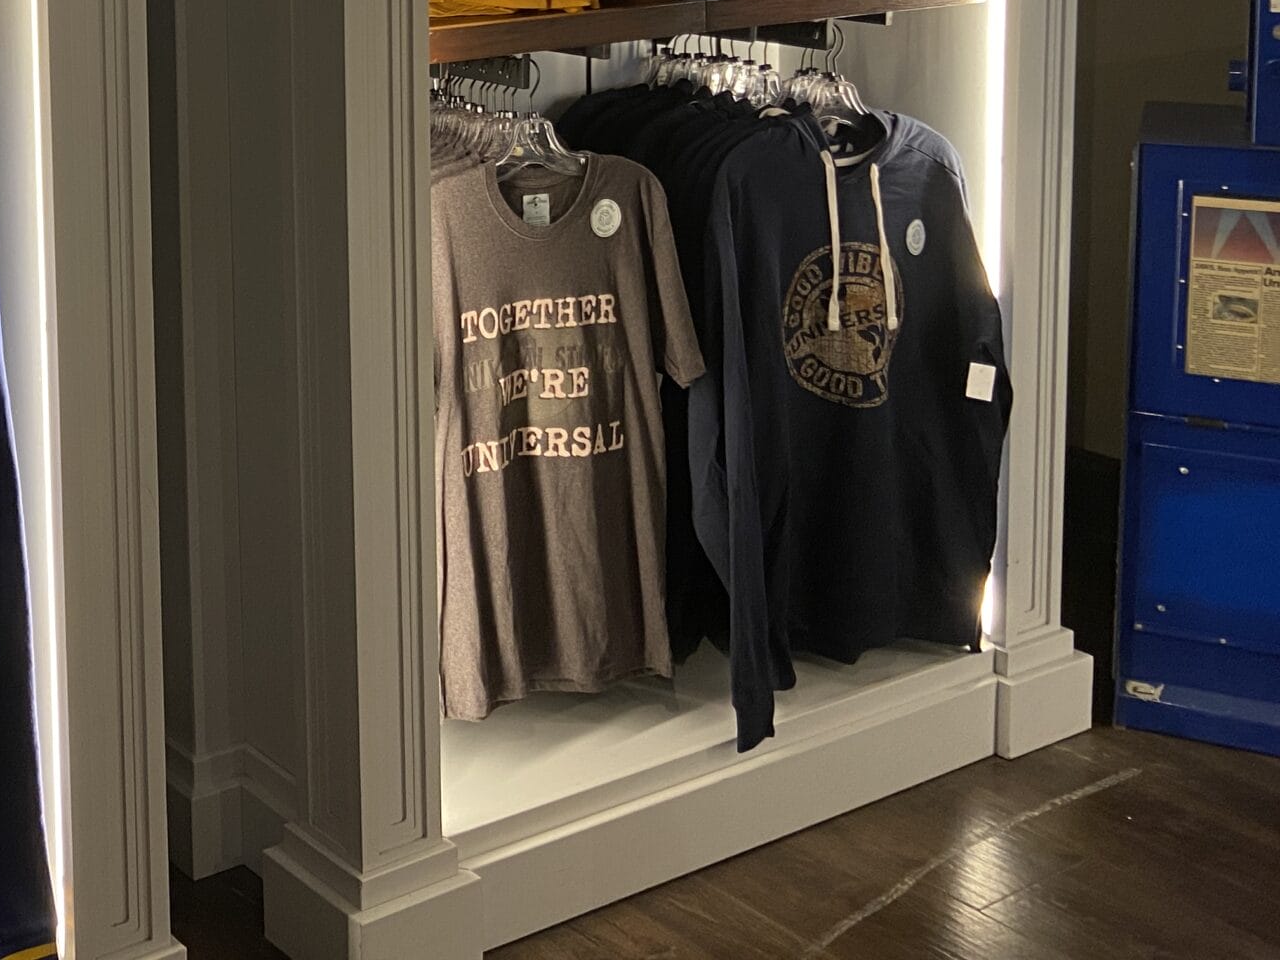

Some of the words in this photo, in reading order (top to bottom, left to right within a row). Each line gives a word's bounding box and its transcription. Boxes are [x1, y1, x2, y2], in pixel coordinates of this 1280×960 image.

[461, 293, 617, 344] TOGETHER
[498, 366, 590, 407] WE'RE
[799, 357, 864, 398] GOOD
[460, 420, 624, 478] UNIVERSAL
